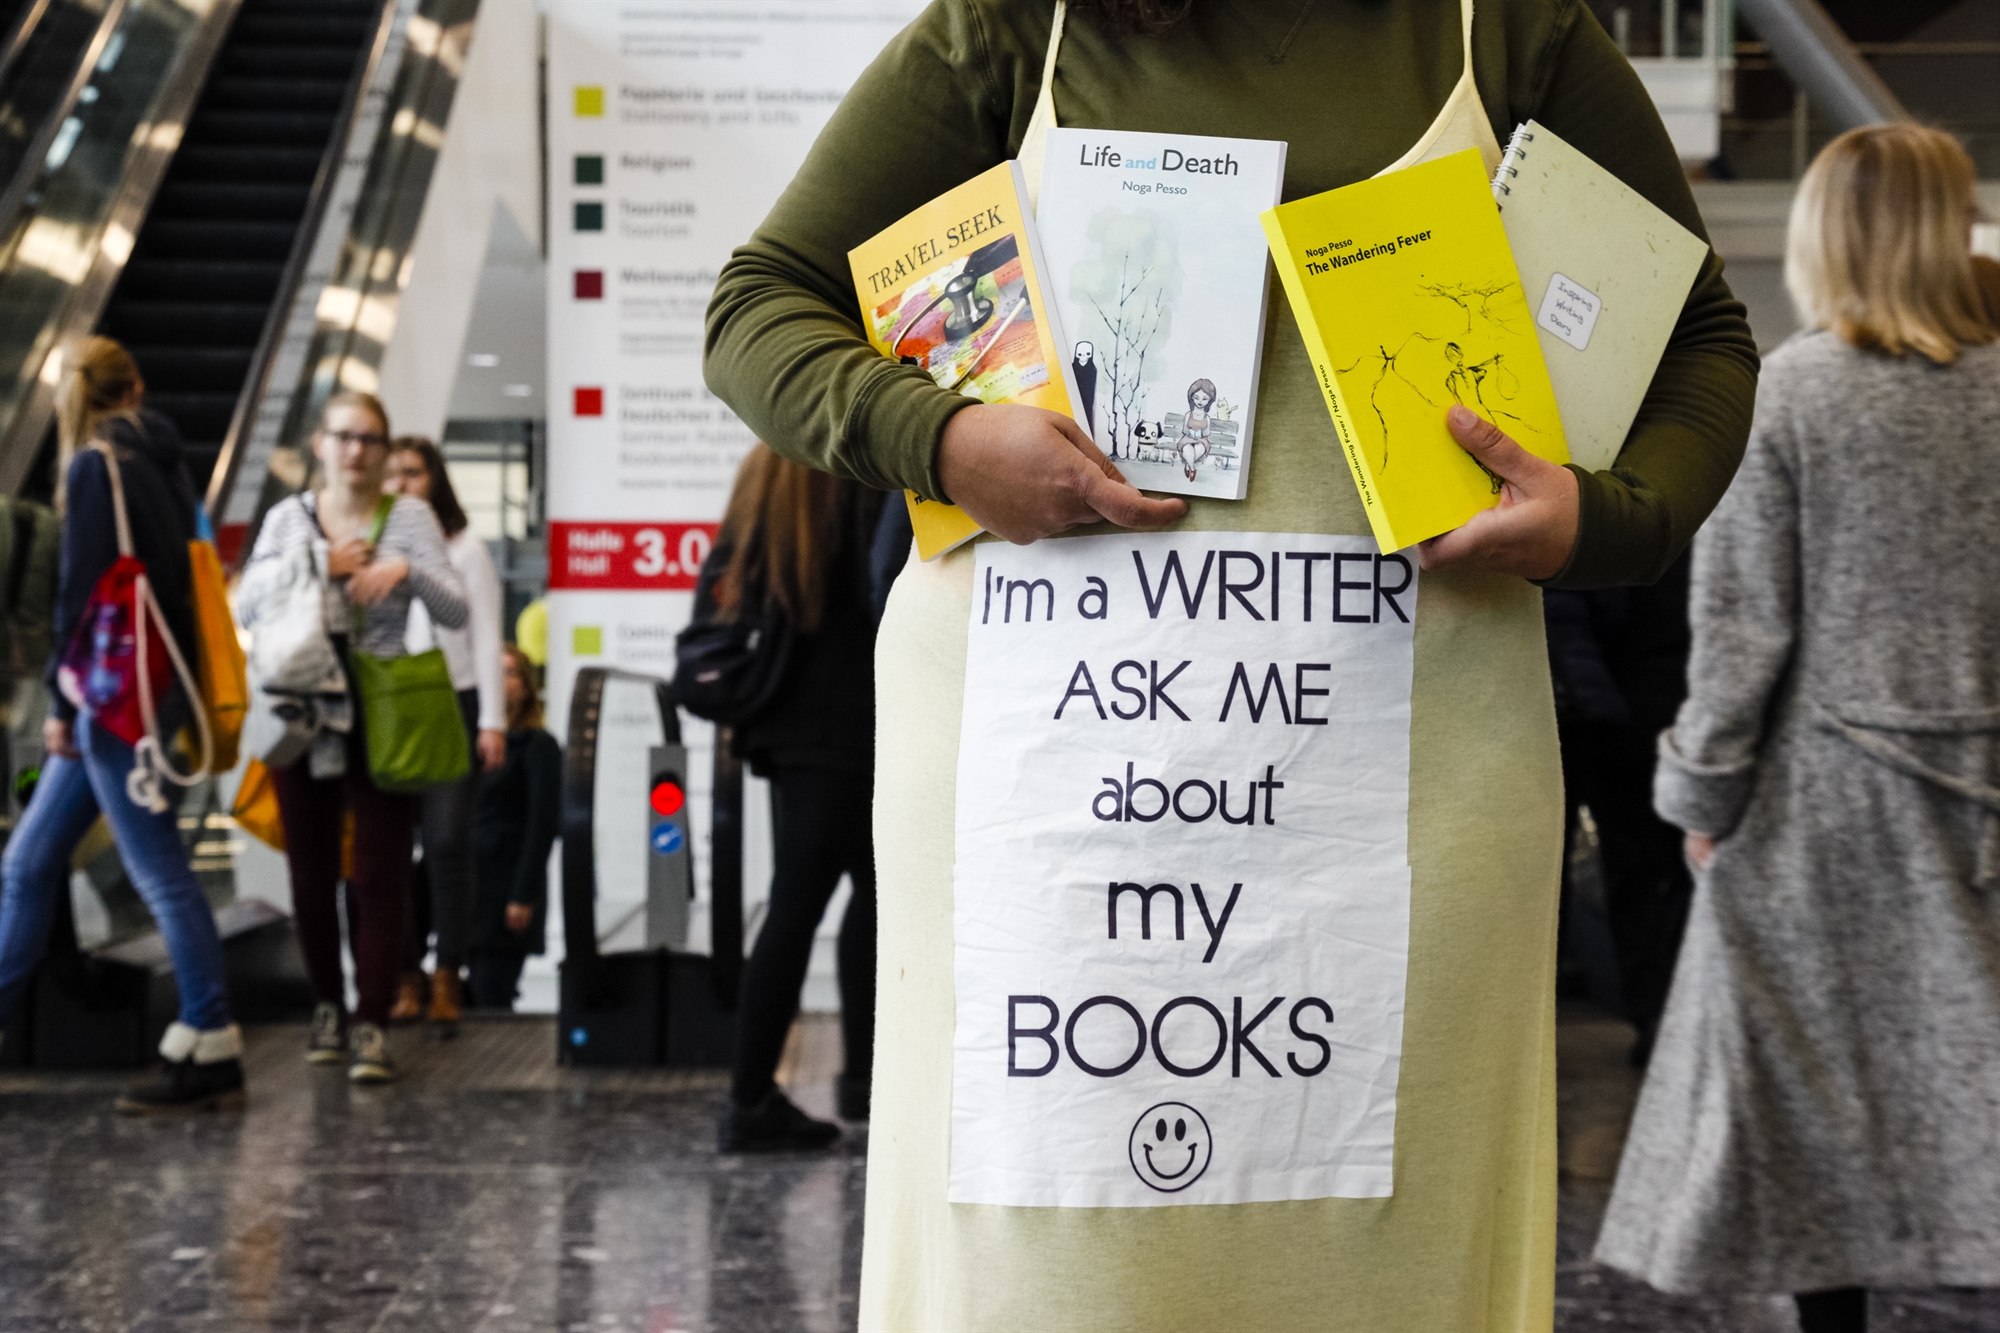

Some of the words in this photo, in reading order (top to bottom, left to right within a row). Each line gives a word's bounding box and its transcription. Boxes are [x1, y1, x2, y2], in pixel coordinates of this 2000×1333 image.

[1080, 144, 1121, 168] Life
[1125, 157, 1157, 170] and
[1161, 149, 1239, 176] Death
[1122, 180, 1152, 195] Noga
[1155, 183, 1188, 195] Pesso
[868, 238, 944, 295] TRAVEL
[946, 204, 1006, 250] SEEK
[1305, 245, 1329, 259] Noga
[1329, 237, 1353, 252] Pesso
[1305, 260, 1329, 277] The
[1329, 240, 1397, 270] Wandering
[1396, 228, 1432, 250] Fever
[1555, 298, 1584, 326] Writing
[1319, 364, 1331, 389] Pesso
[1328, 389, 1340, 413] Noga
[1339, 419, 1350, 443] Fever
[1349, 444, 1367, 490] Wandering
[1362, 490, 1373, 506] The
[633, 528, 712, 577] 3.0
[982, 566, 1055, 625] I'm
[1077, 575, 1108, 620] a
[1132, 550, 1413, 624] WRITER
[1053, 659, 1192, 722] ASK
[1218, 661, 1331, 725] ME
[1092, 761, 1284, 826] about
[1108, 881, 1243, 963] my
[1007, 994, 1334, 1078] BOOKS
